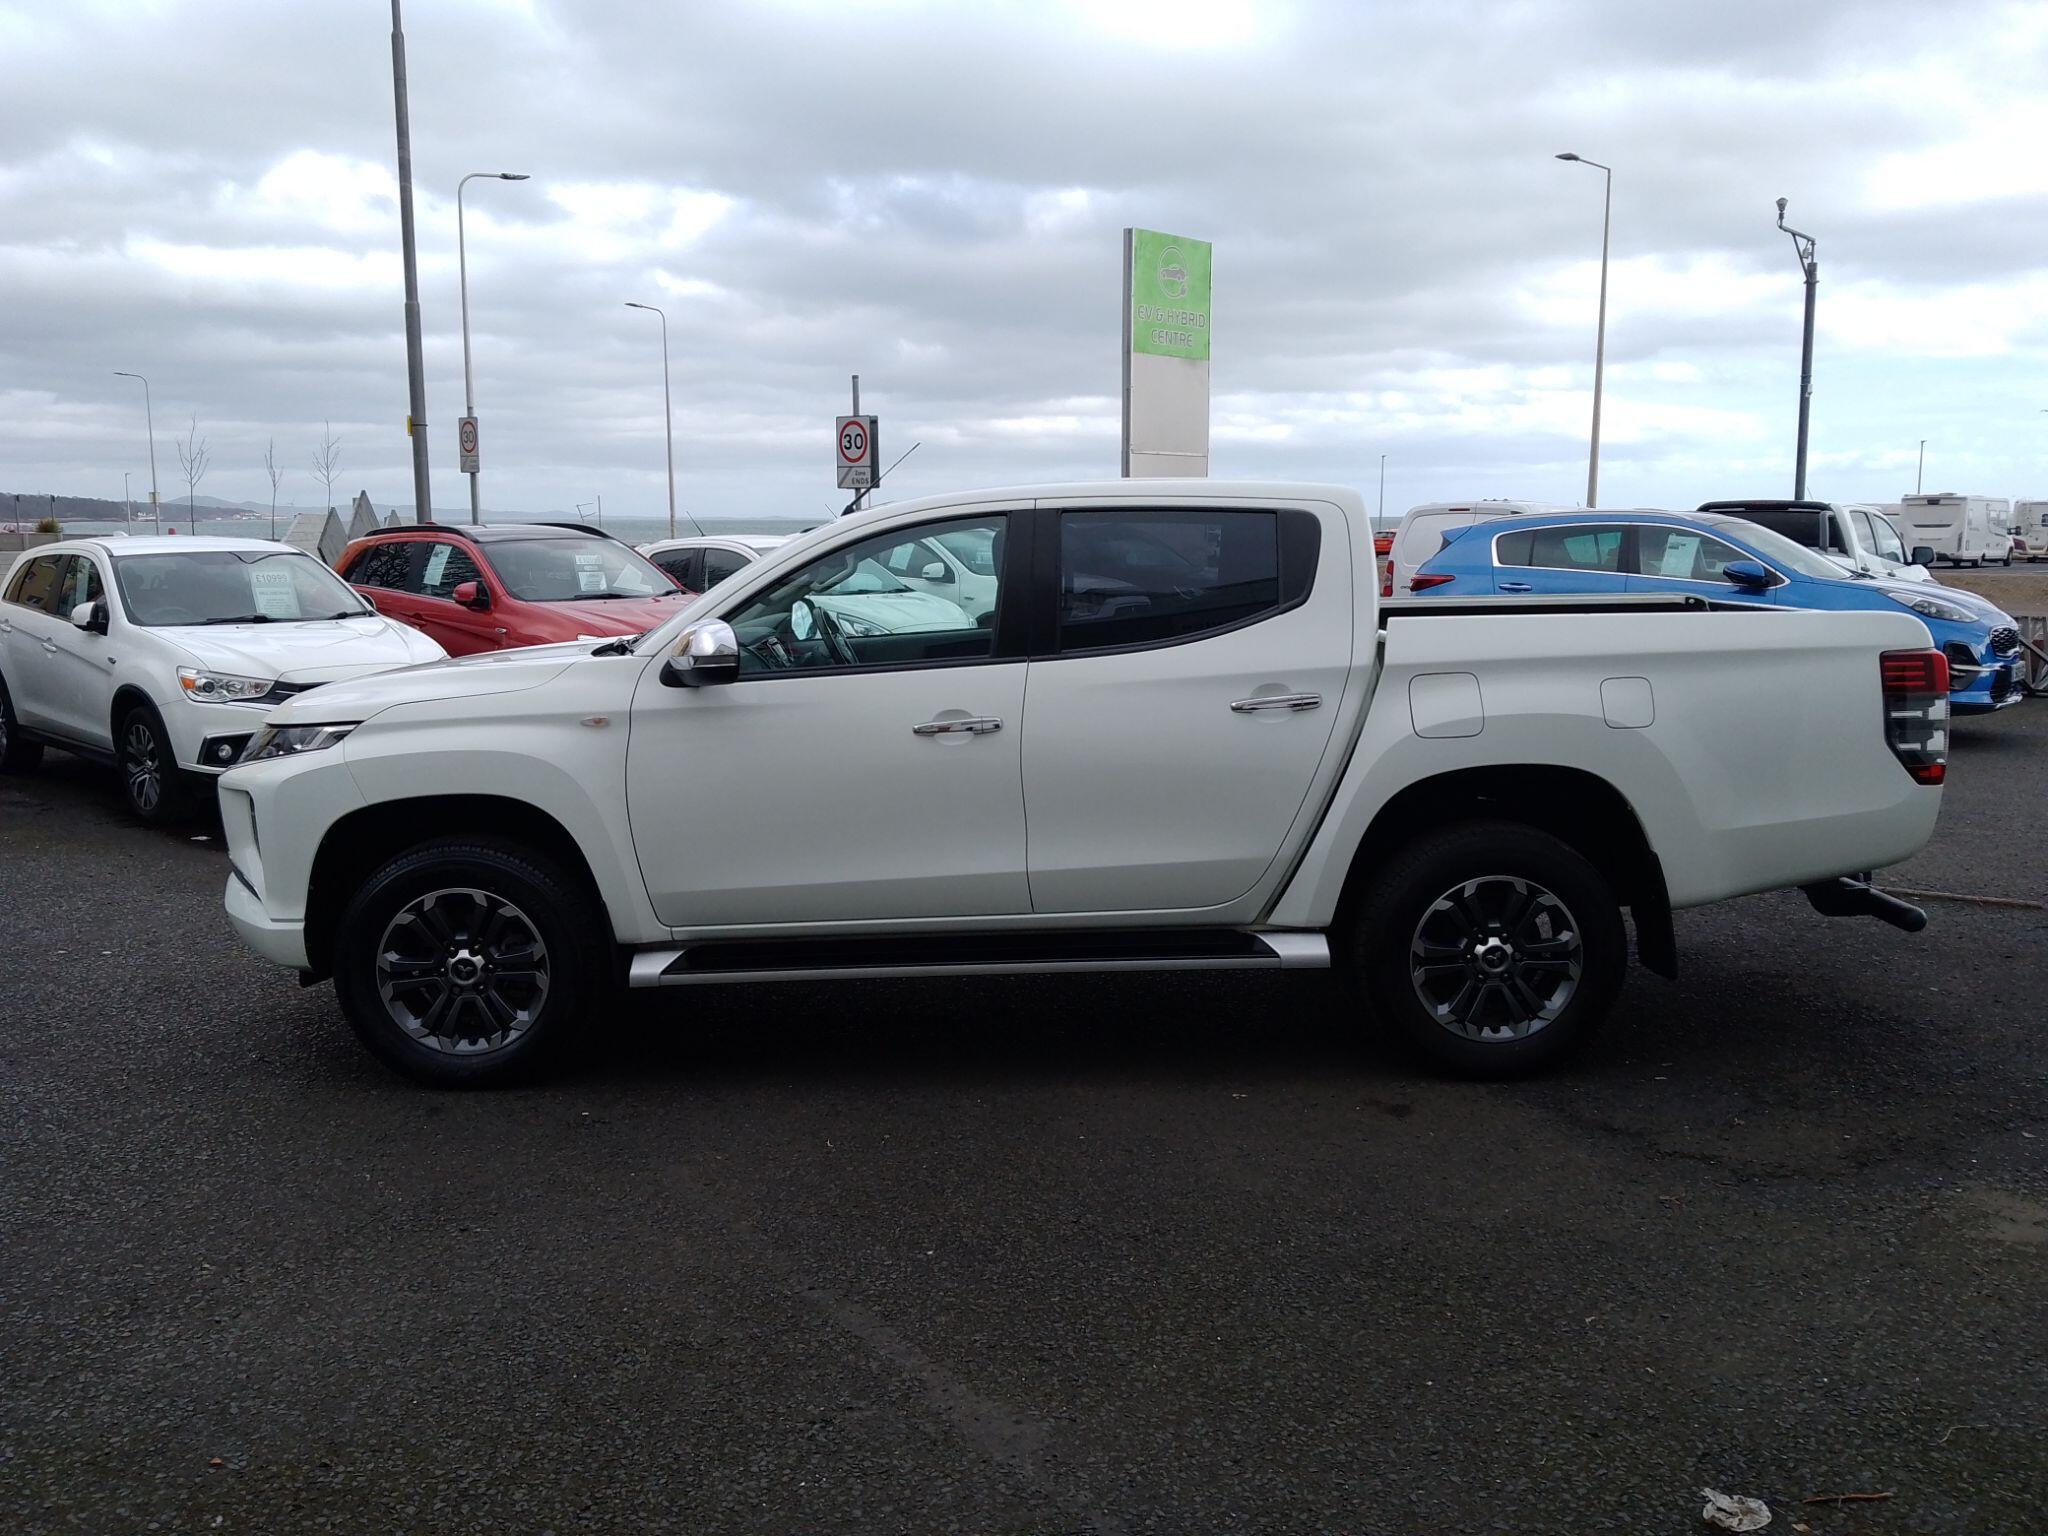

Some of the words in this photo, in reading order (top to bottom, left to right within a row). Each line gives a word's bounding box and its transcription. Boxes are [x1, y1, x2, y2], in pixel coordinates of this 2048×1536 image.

[1138, 305, 1152, 320] EV
[1155, 307, 1164, 322] &
[1167, 309, 1206, 328] HYBRID
[1151, 329, 1193, 347] CENTRE
[463, 431, 474, 443] 30
[843, 433, 864, 450] 30
